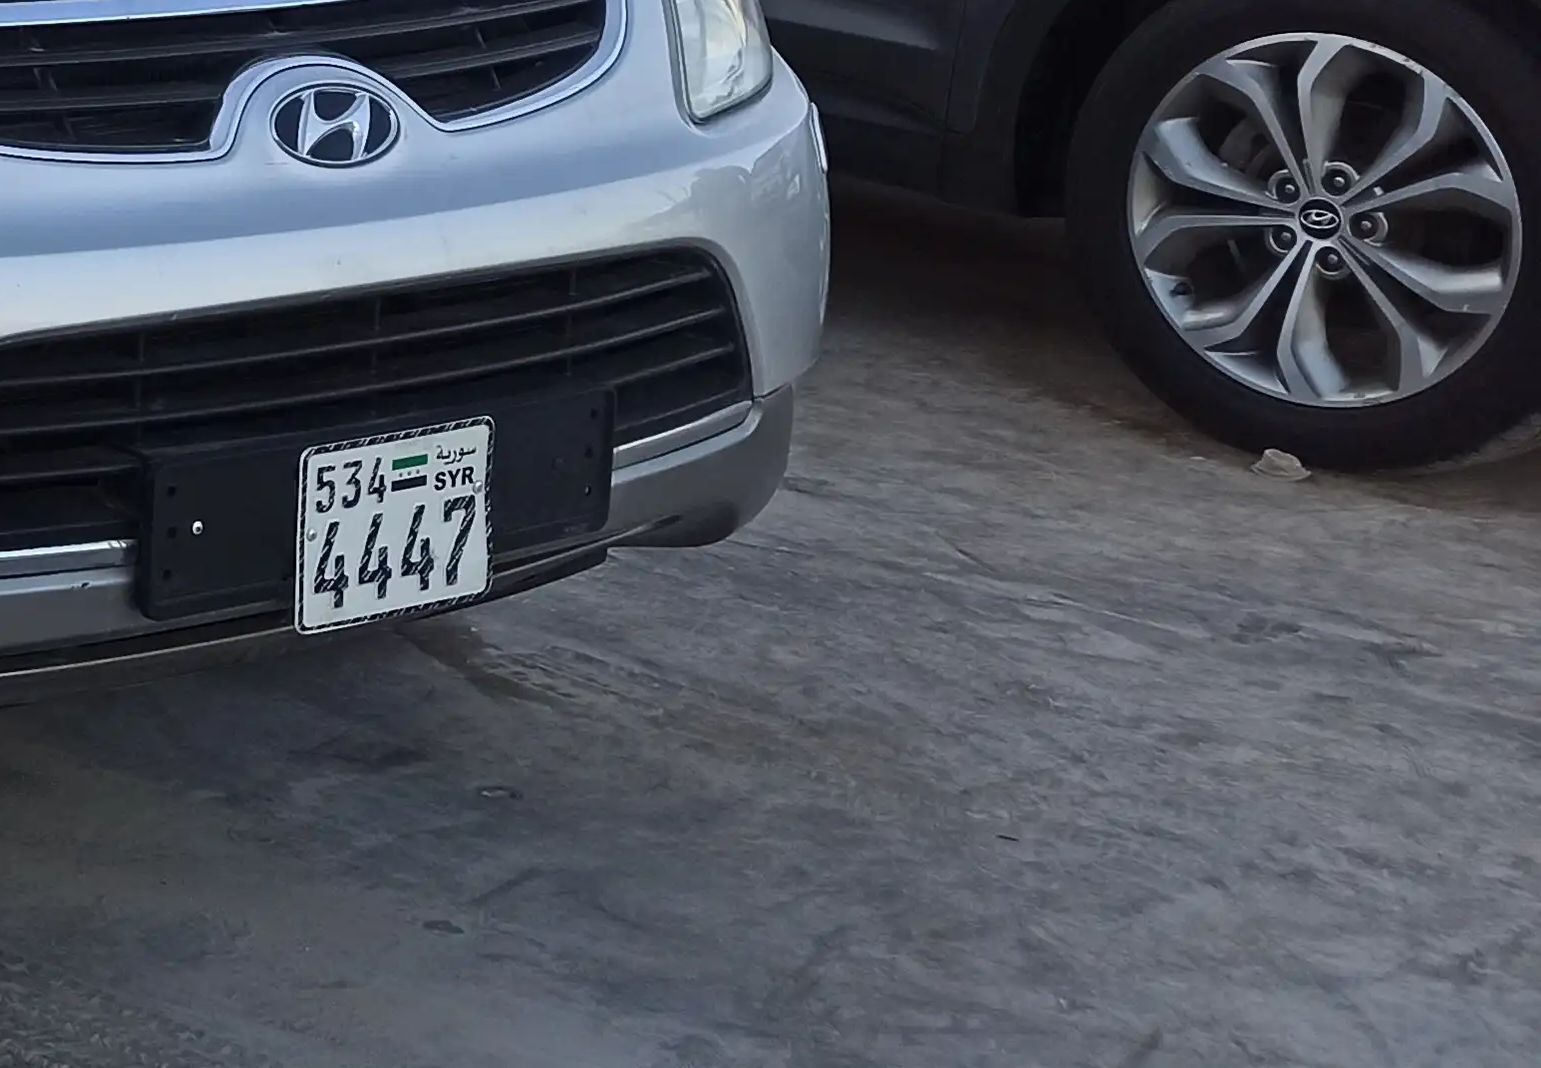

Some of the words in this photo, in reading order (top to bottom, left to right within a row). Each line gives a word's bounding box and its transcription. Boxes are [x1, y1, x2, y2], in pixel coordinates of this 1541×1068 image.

[435, 444, 477, 466] سورية
[315, 456, 387, 514] 534
[433, 466, 475, 492] SYR
[313, 494, 477, 609] 4447
